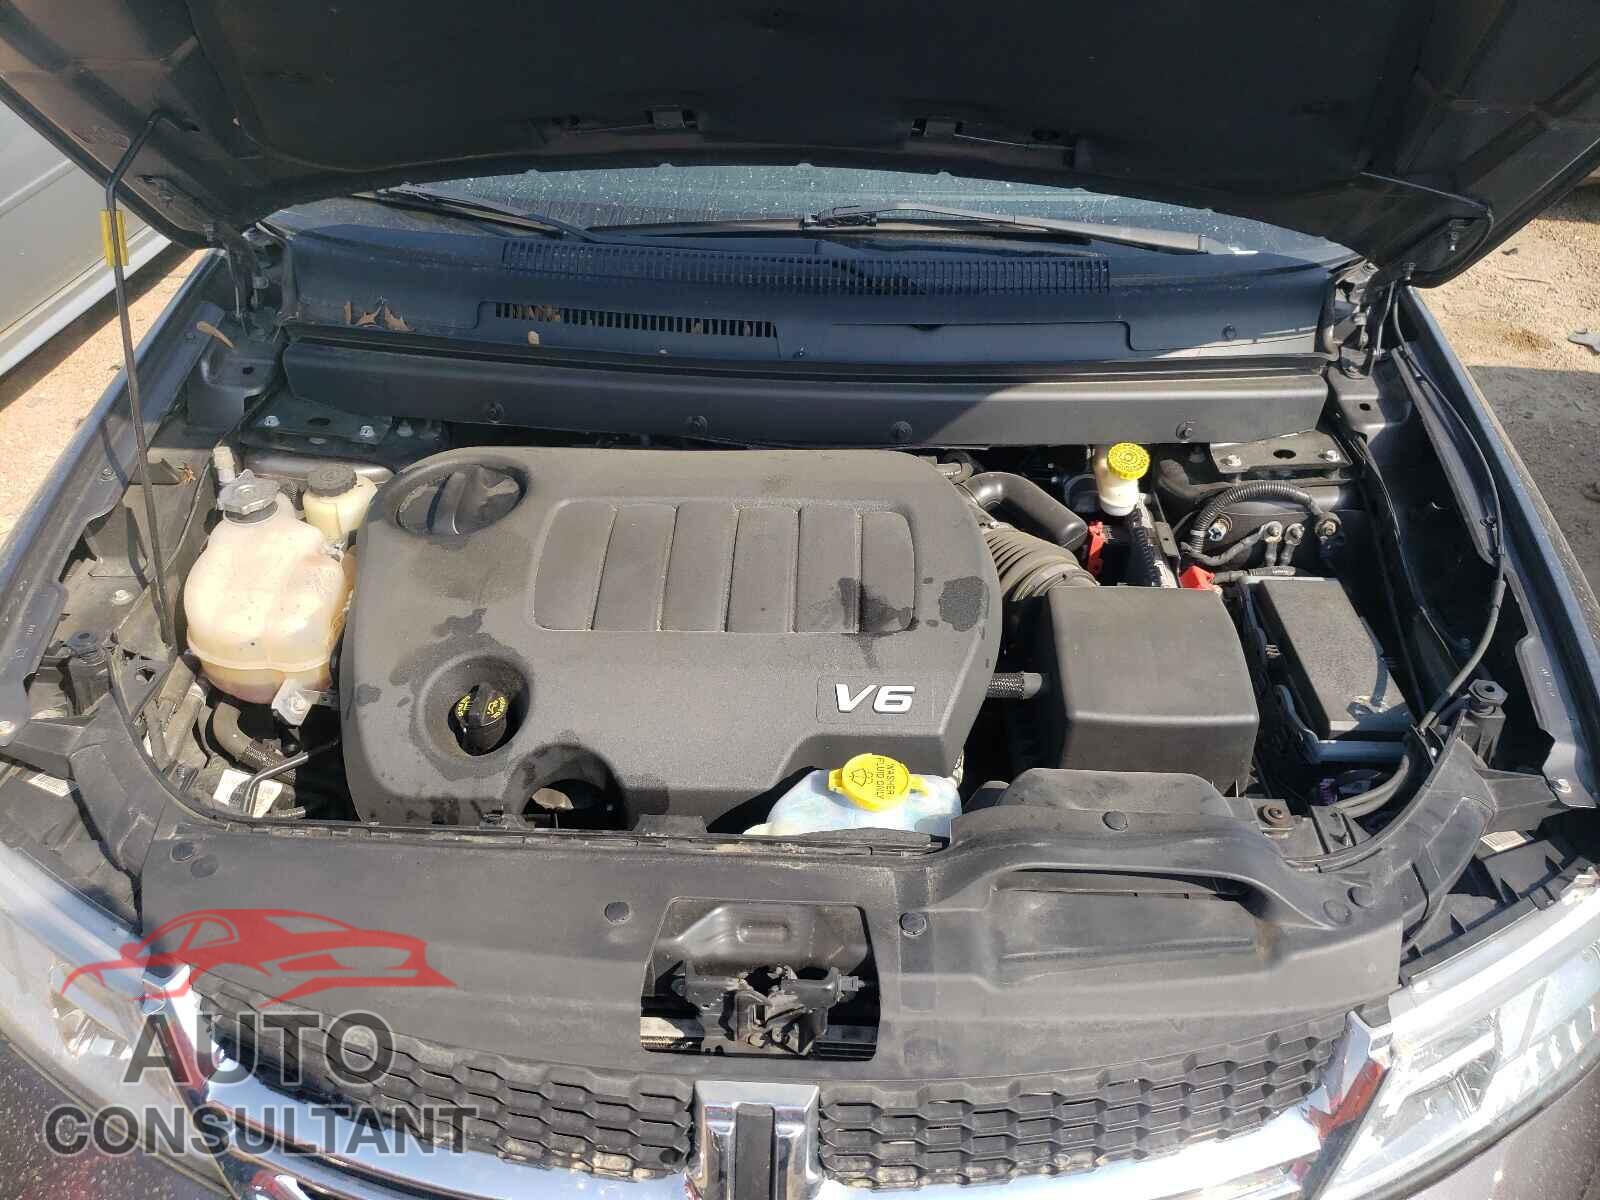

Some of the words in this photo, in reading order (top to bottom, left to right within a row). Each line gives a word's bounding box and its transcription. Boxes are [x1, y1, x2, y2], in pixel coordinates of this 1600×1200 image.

[835, 683, 916, 714] V6
[875, 757, 885, 779] FLUID
[886, 763, 896, 795] WASHER
[875, 780, 885, 800] ONLY
